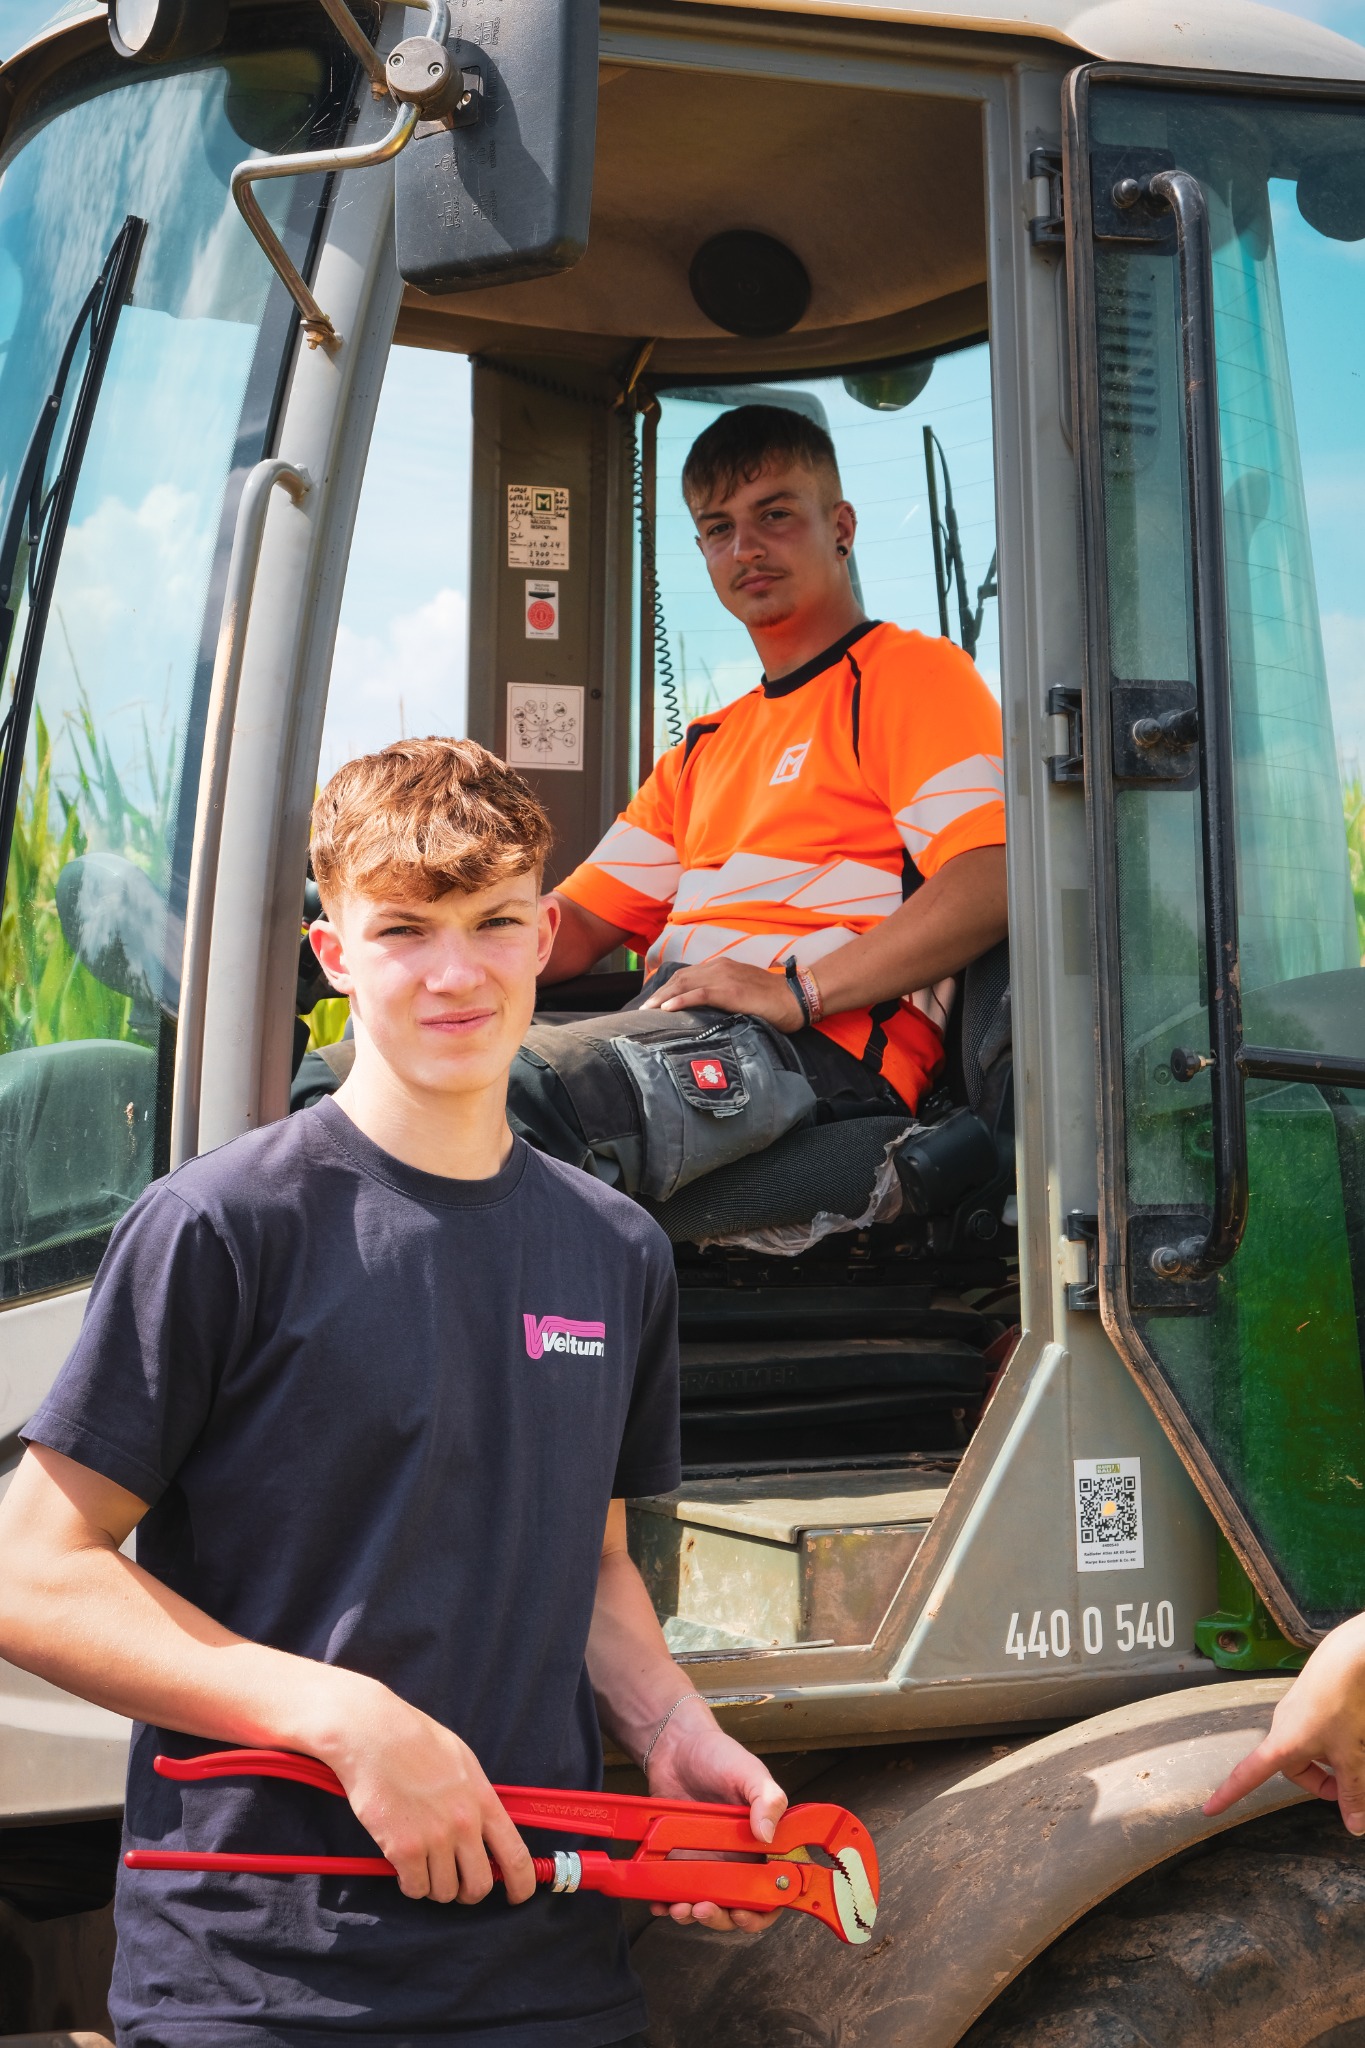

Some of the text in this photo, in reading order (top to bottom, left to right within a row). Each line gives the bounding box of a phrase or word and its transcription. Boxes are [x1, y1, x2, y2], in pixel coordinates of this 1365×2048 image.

[541, 1331, 605, 1358] Veltum
[1005, 1600, 1175, 1660] 440 0 540
